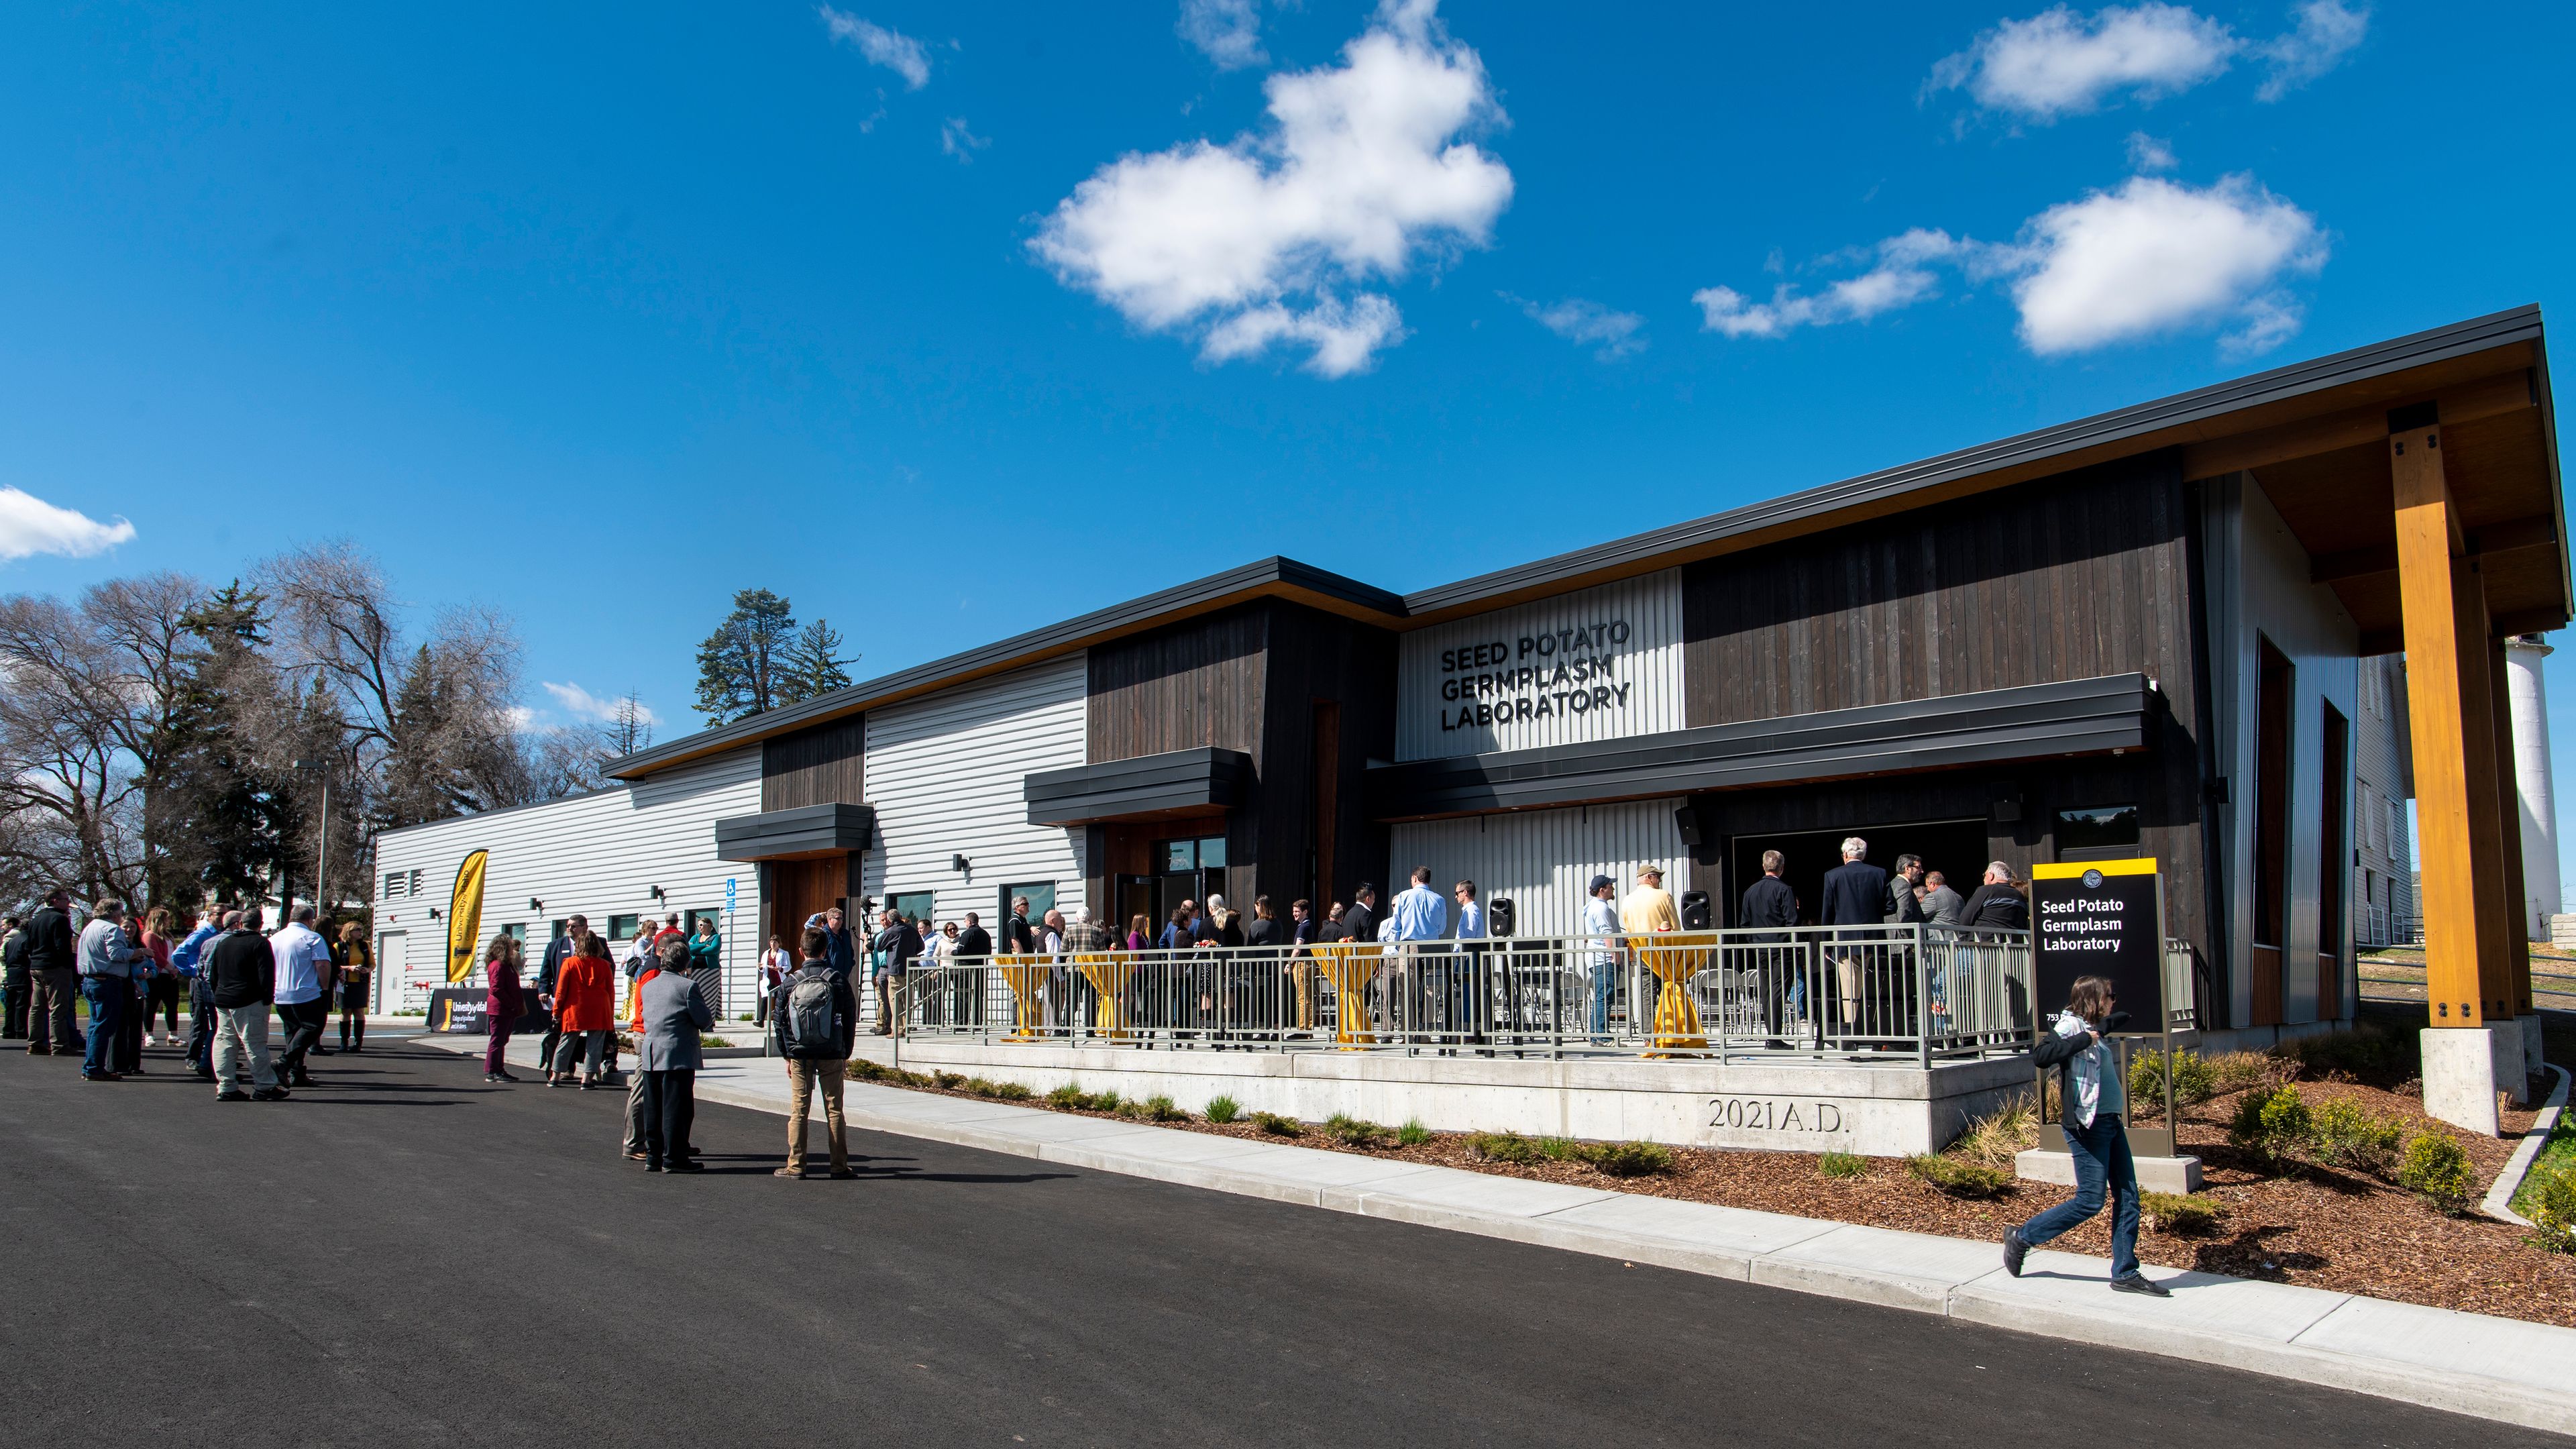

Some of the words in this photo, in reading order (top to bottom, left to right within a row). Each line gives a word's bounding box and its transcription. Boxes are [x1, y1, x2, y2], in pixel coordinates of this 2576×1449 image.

[1442, 643, 1508, 672] SEED
[1519, 621, 1629, 659] POTATO
[1442, 654, 1611, 700] GERMPLASM
[1442, 682, 1630, 731] LABORATORY
[455, 900, 467, 941] University
[462, 870, 470, 892] Idaho
[2042, 900, 2074, 914] Seed
[2078, 899, 2124, 912] Potato
[2043, 918, 2122, 934] Germplasm
[2044, 938, 2121, 953] Laboratory
